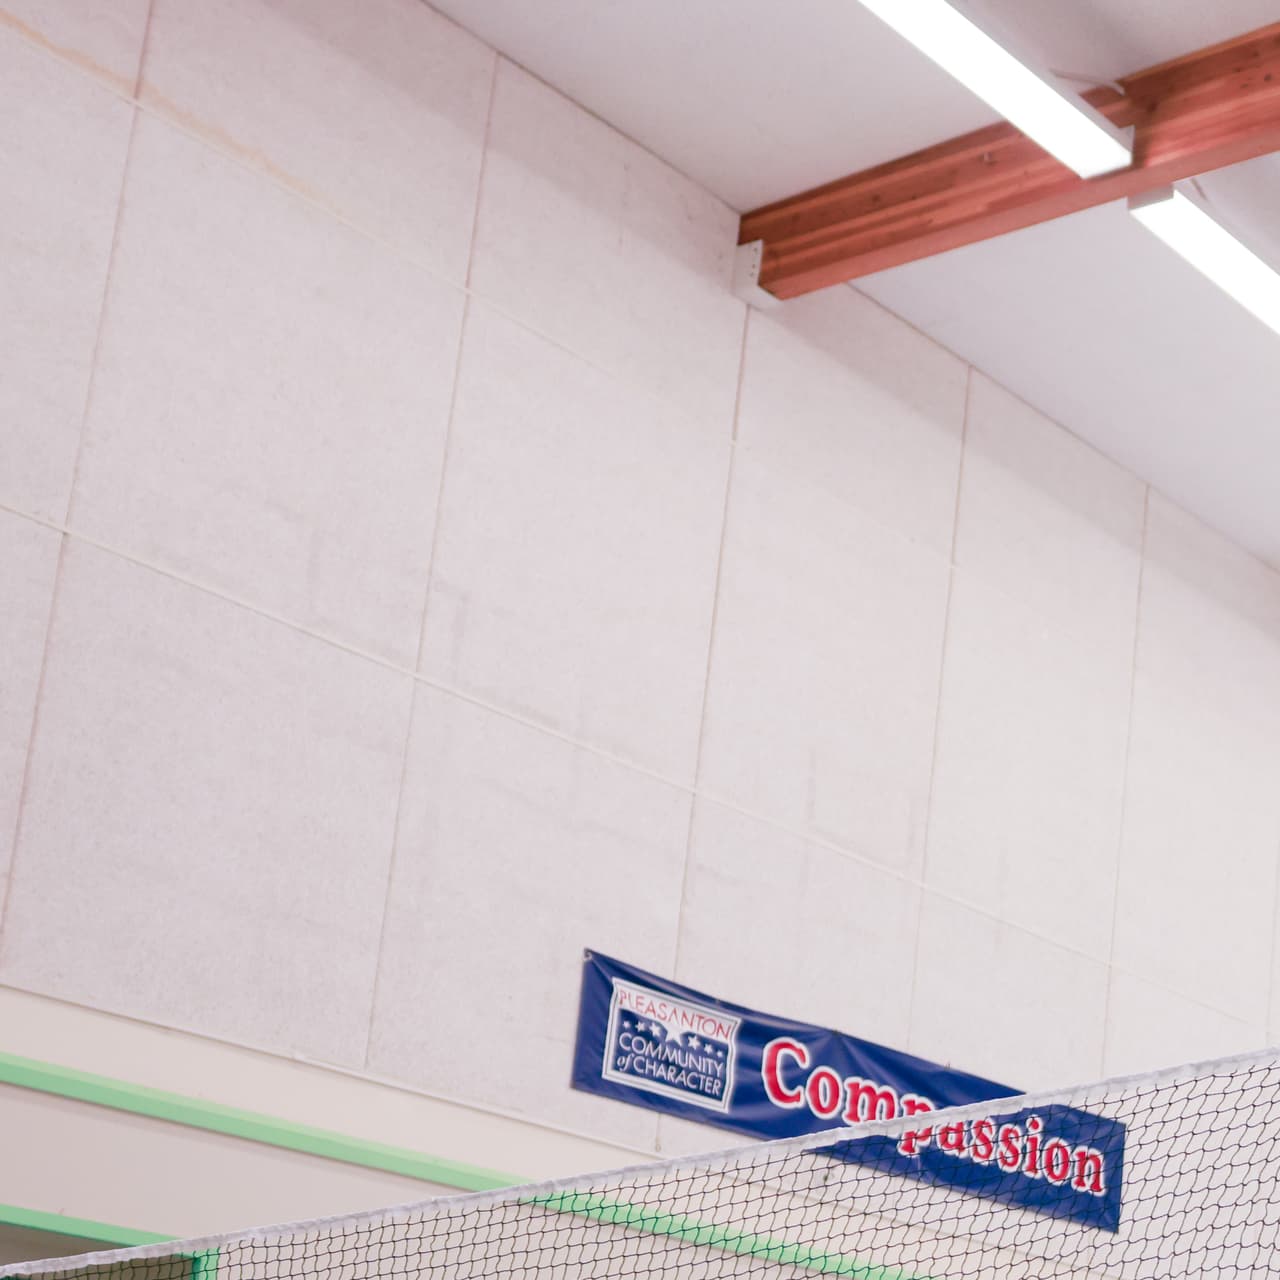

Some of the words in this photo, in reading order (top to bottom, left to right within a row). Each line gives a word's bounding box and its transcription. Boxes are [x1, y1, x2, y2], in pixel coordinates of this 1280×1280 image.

[618, 989, 732, 1041] PLEASANTON
[616, 1053, 634, 1072] of
[632, 1055, 722, 1097] CHARACTER
[618, 1032, 724, 1078] COMMUNITY
[762, 1038, 1105, 1195] Compassion
